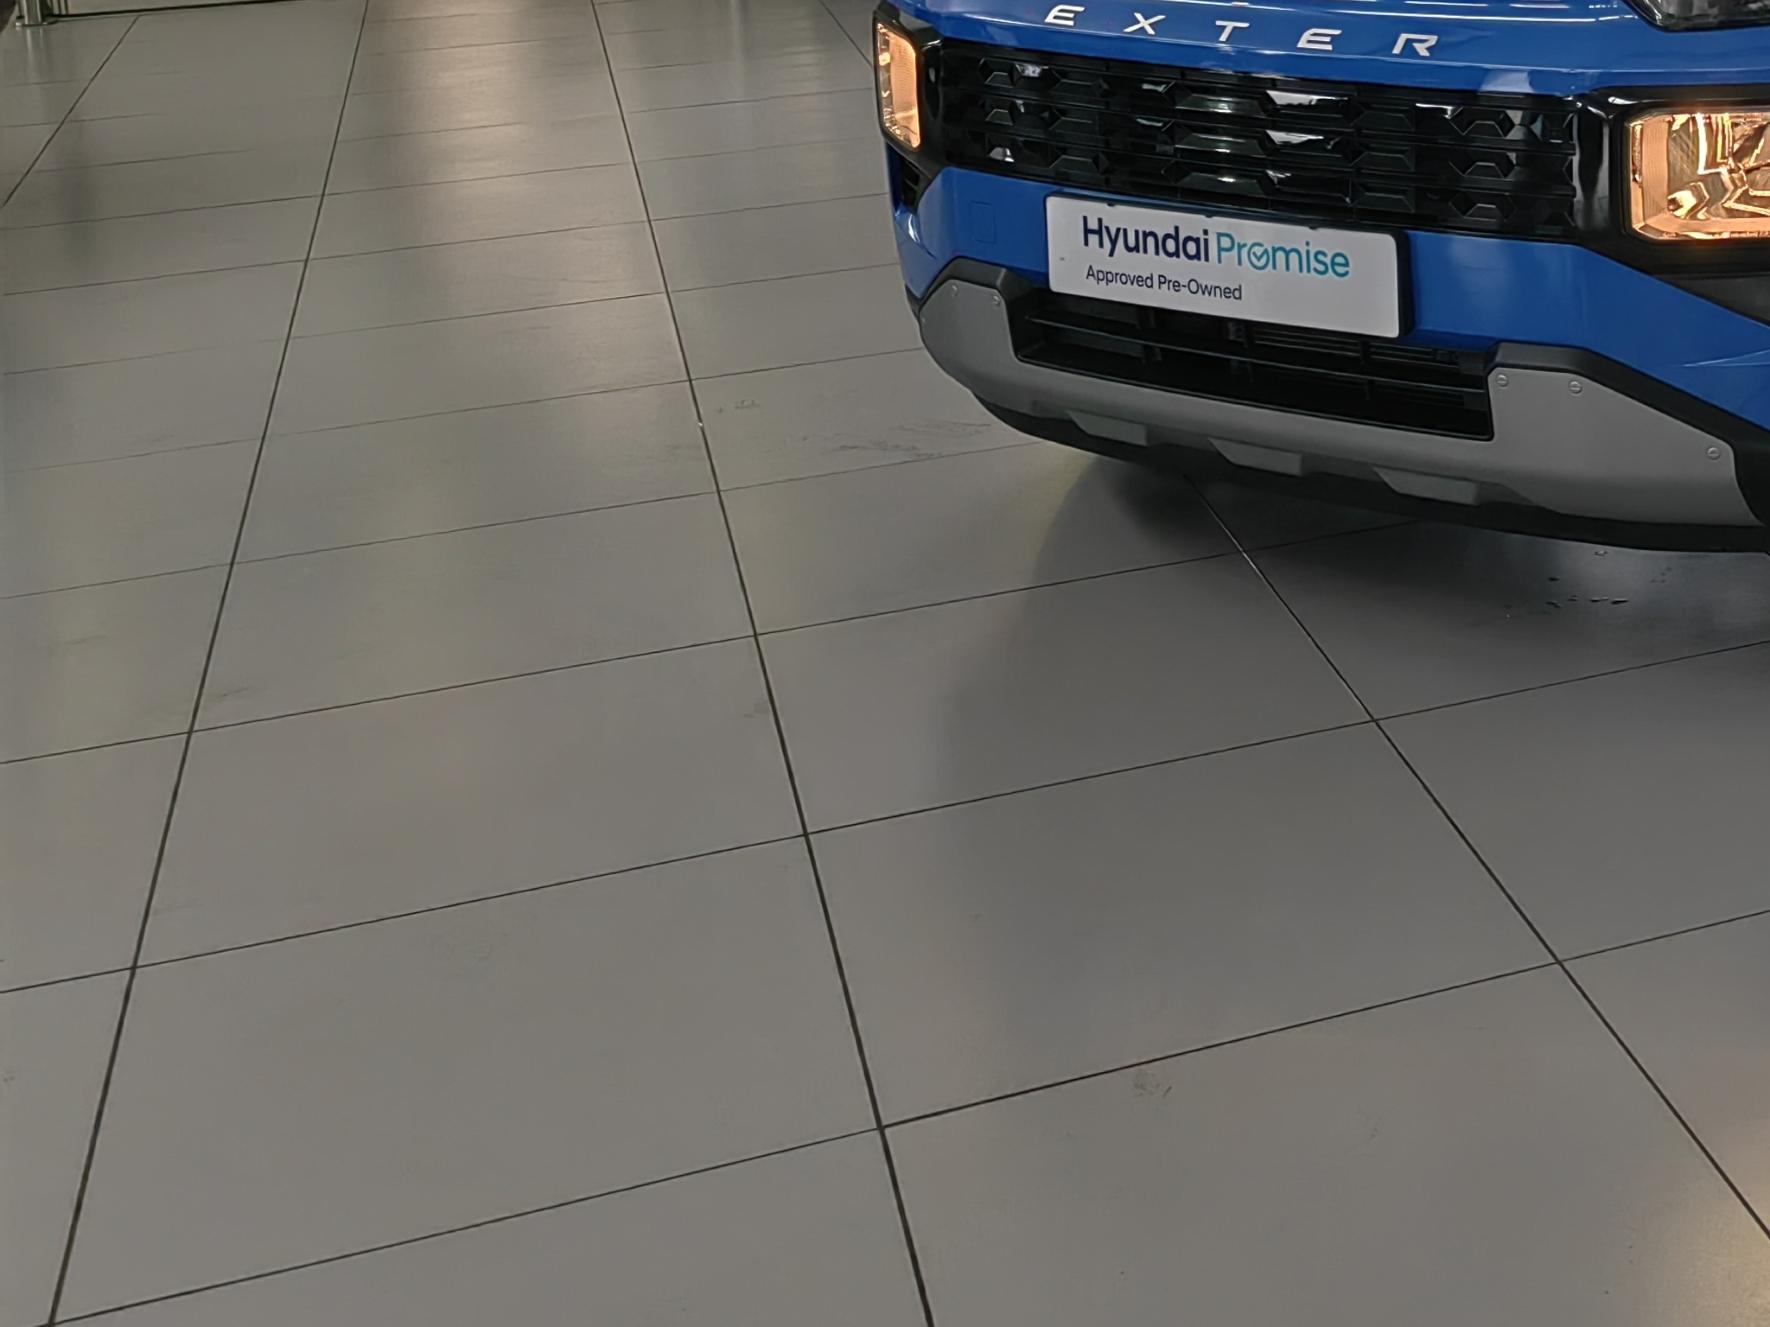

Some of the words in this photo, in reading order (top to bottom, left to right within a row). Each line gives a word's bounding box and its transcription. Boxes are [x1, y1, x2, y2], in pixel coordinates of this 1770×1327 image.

[1044, 4, 1439, 57] EXTER
[1082, 215, 1210, 263] Hyundai
[1216, 232, 1351, 278] Promise
[1085, 265, 1154, 289] Approved
[1157, 274, 1243, 301] Pre-Owned
